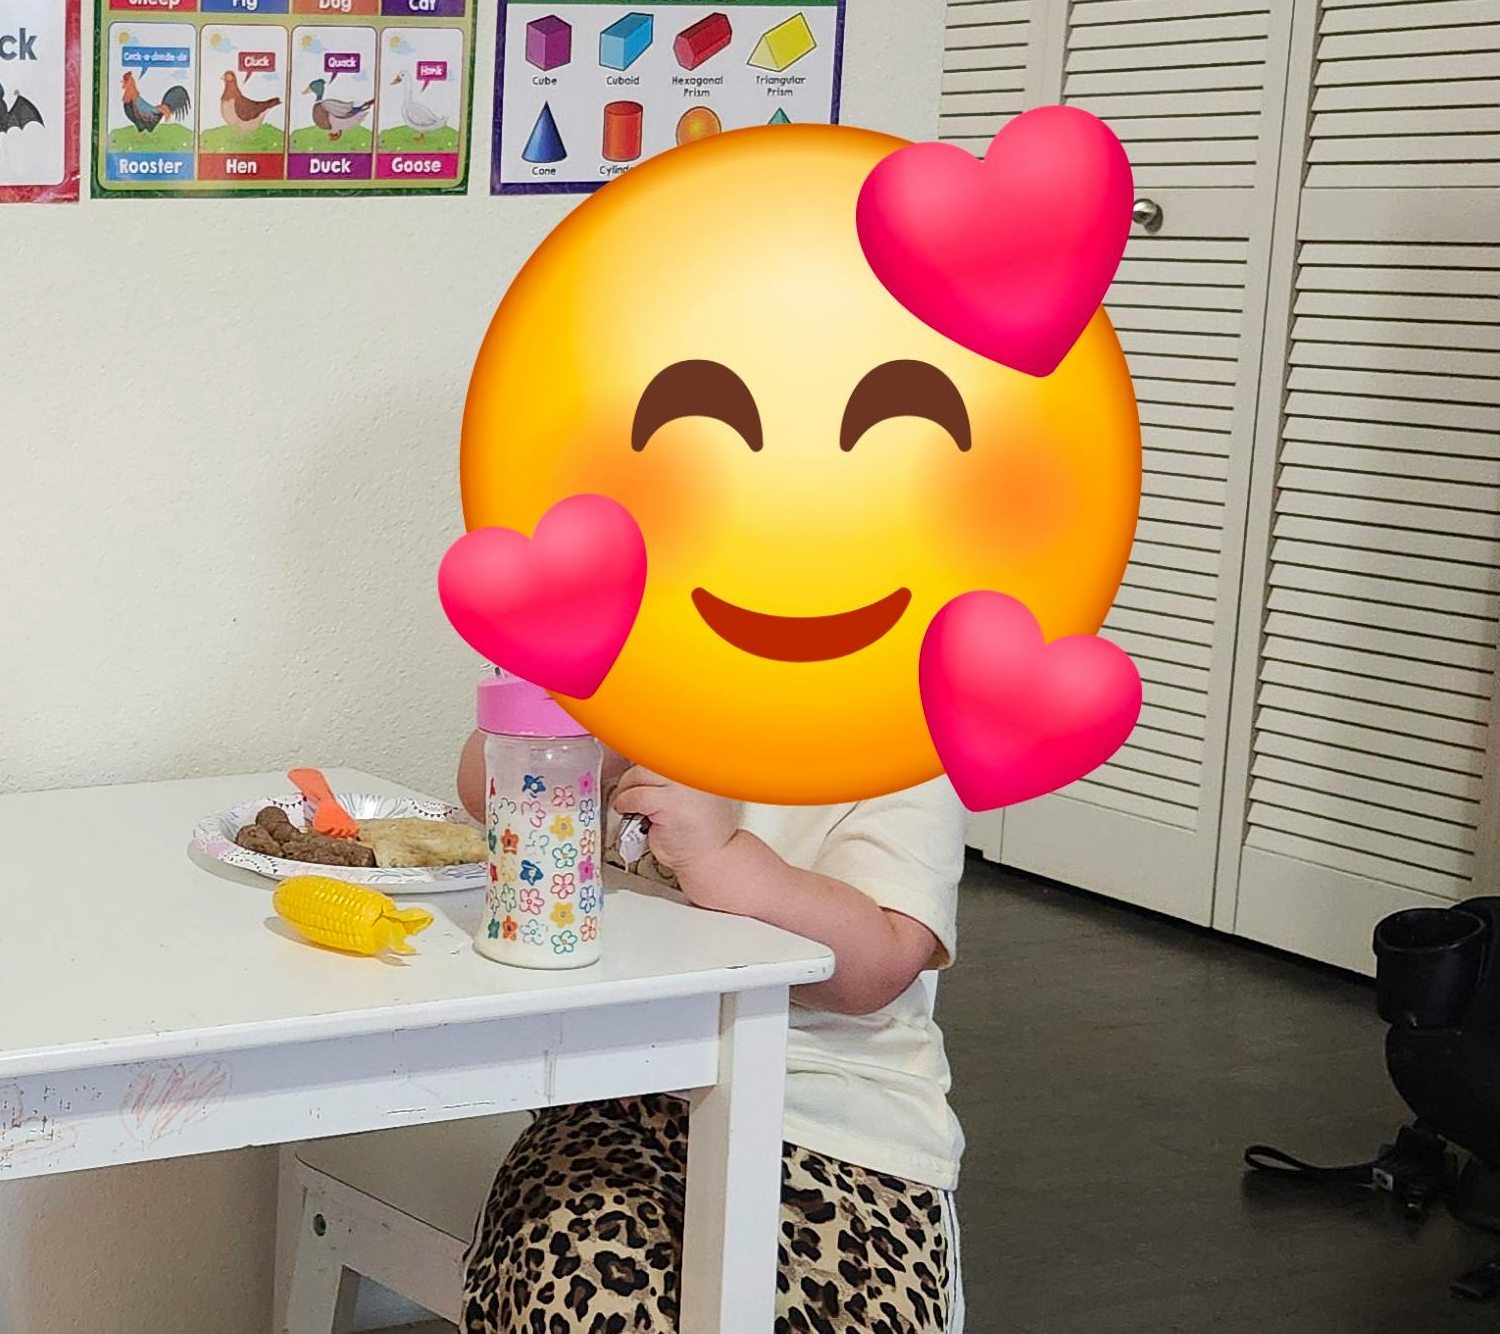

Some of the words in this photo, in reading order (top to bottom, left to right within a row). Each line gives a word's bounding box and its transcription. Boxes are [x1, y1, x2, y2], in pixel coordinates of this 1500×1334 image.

[244, 56, 270, 68] Cluck
[328, 57, 357, 69] Quack
[531, 76, 558, 86] Cube
[606, 75, 641, 86] Cuboid
[671, 75, 725, 87] Hexagonal
[755, 75, 807, 86] Triangular
[683, 87, 711, 98] Prism
[766, 86, 794, 97] Prism
[119, 158, 183, 174] Rooster
[226, 158, 257, 174] Hen
[309, 158, 351, 174] Duck
[391, 157, 441, 173] Goose
[531, 166, 557, 176] Cone
